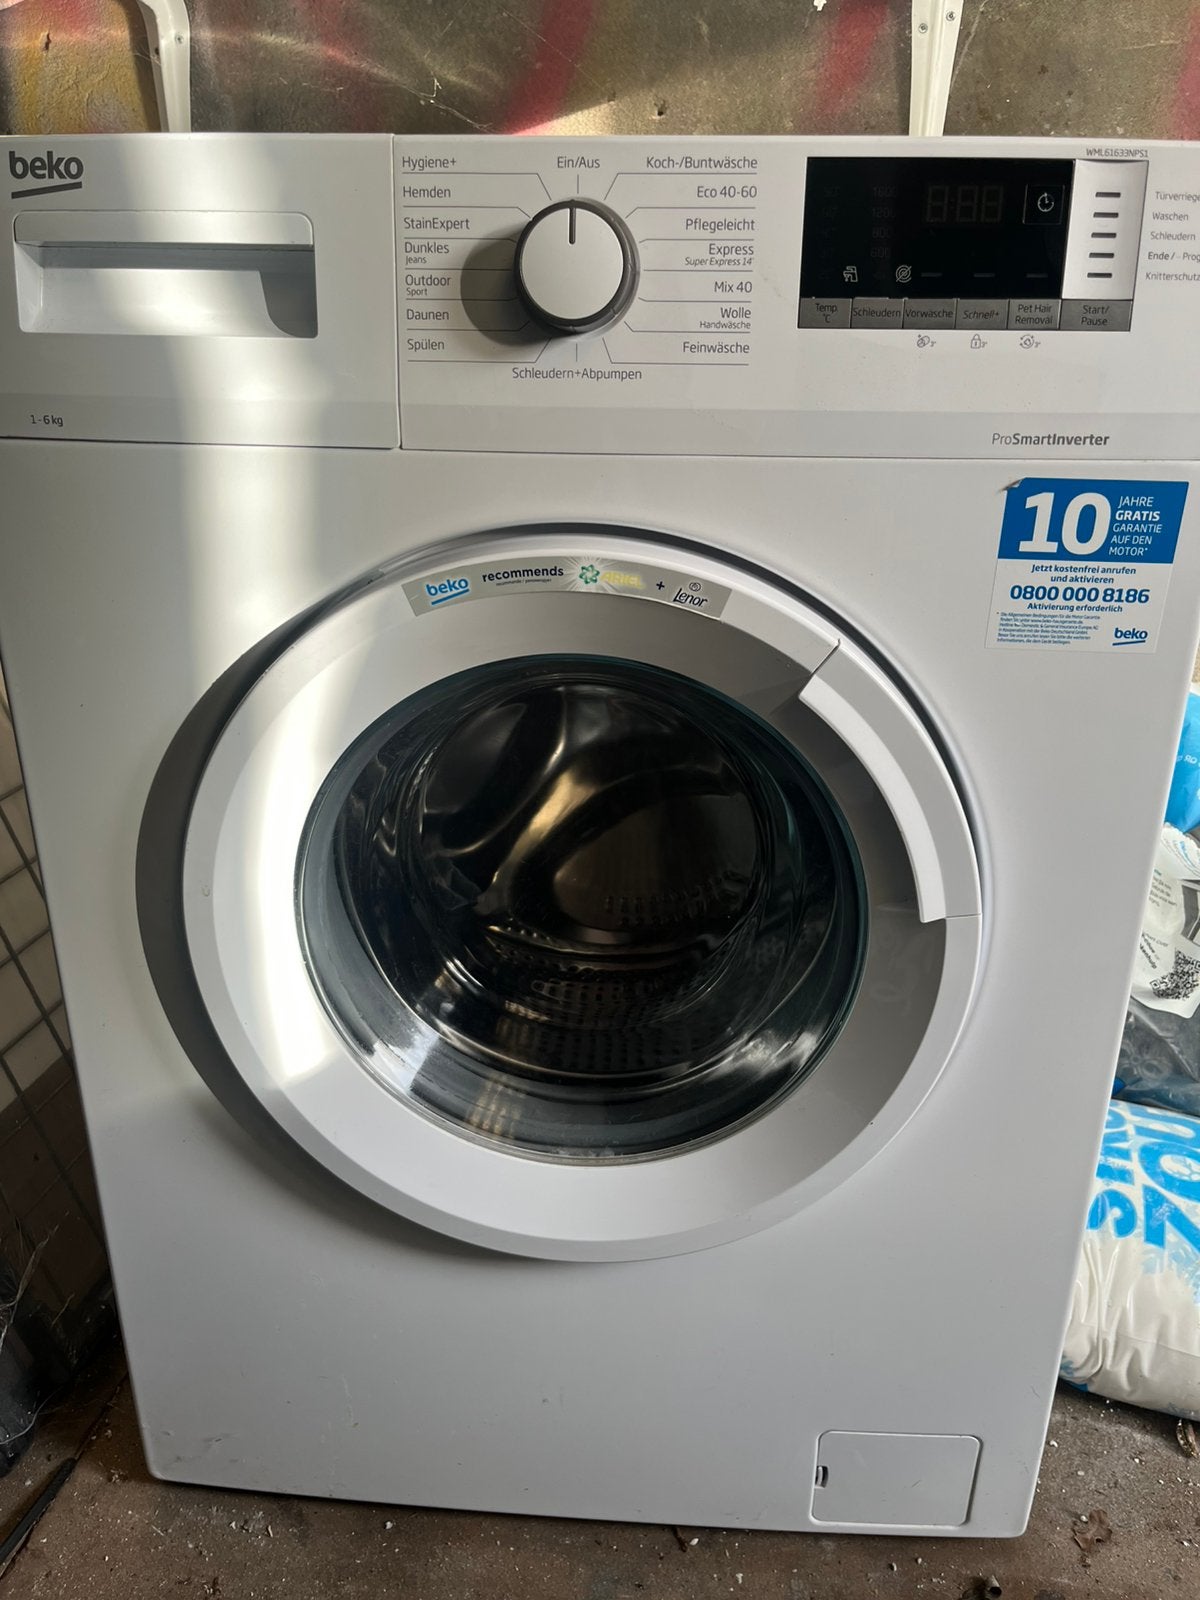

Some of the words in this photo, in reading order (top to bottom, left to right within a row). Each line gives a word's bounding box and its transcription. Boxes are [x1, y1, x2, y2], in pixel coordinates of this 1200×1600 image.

[1085, 147, 1149, 159] WML61633NPS1
[8, 150, 84, 180] beko
[402, 156, 457, 171] Hygiene+
[557, 155, 601, 169] Ein/Aus
[646, 156, 758, 169] Koch-/Buntwäsche
[403, 186, 451, 198] Hemden
[697, 185, 718, 199] Eco
[720, 185, 758, 199] 40-60
[1152, 211, 1189, 221] Waschen
[404, 217, 470, 232] StainExpert
[685, 218, 756, 234] Pflegeleicht
[1150, 231, 1196, 241] Schleudern
[404, 241, 450, 254] Dunkles
[708, 243, 754, 258] Express
[405, 255, 427, 265] Jeans
[685, 256, 709, 267] Super
[709, 256, 741, 267] Express
[1147, 251, 1170, 261] Ende
[405, 274, 451, 287] Outdoor
[406, 287, 428, 297] Sport
[714, 281, 734, 293] Mix
[736, 281, 753, 293] 40
[720, 306, 751, 319] Wolle
[815, 302, 838, 314] Temp
[852, 307, 901, 318] Schleudern
[1017, 303, 1033, 314] Pet
[1034, 303, 1052, 314] Hair
[1082, 304, 1110, 315] Start/
[406, 308, 450, 321] Daunen
[1015, 315, 1053, 325] Removal
[700, 319, 751, 329] Handwäsche
[1081, 316, 1108, 326] Pause
[407, 338, 445, 352] Spülen
[683, 341, 750, 354] Feinwäsche
[512, 367, 643, 382] Schleudern+Abpumpen
[991, 432, 1110, 446] ProSmartInverter
[1117, 496, 1155, 509] JAHRE
[1115, 510, 1161, 522] GRATIS
[1018, 491, 1112, 556] 10
[1112, 523, 1163, 533] GARANTIE
[1110, 535, 1131, 545] AUF
[1131, 535, 1153, 545] DEN
[1031, 563, 1052, 574] Jetzt
[1053, 564, 1100, 574] kostenfrei
[1101, 565, 1137, 575] anrufen
[1050, 575, 1068, 583] und
[1068, 575, 1115, 584] aktivieren
[424, 578, 470, 597] beko
[482, 565, 565, 583] recommends
[673, 587, 708, 607] Lenor
[1010, 584, 1059, 601] 0800
[1062, 586, 1100, 602] 000
[1102, 588, 1150, 604] 8186
[1027, 602, 1075, 613] Aktivierung
[1075, 604, 1123, 613] erforderlich
[1114, 627, 1148, 641] beko
